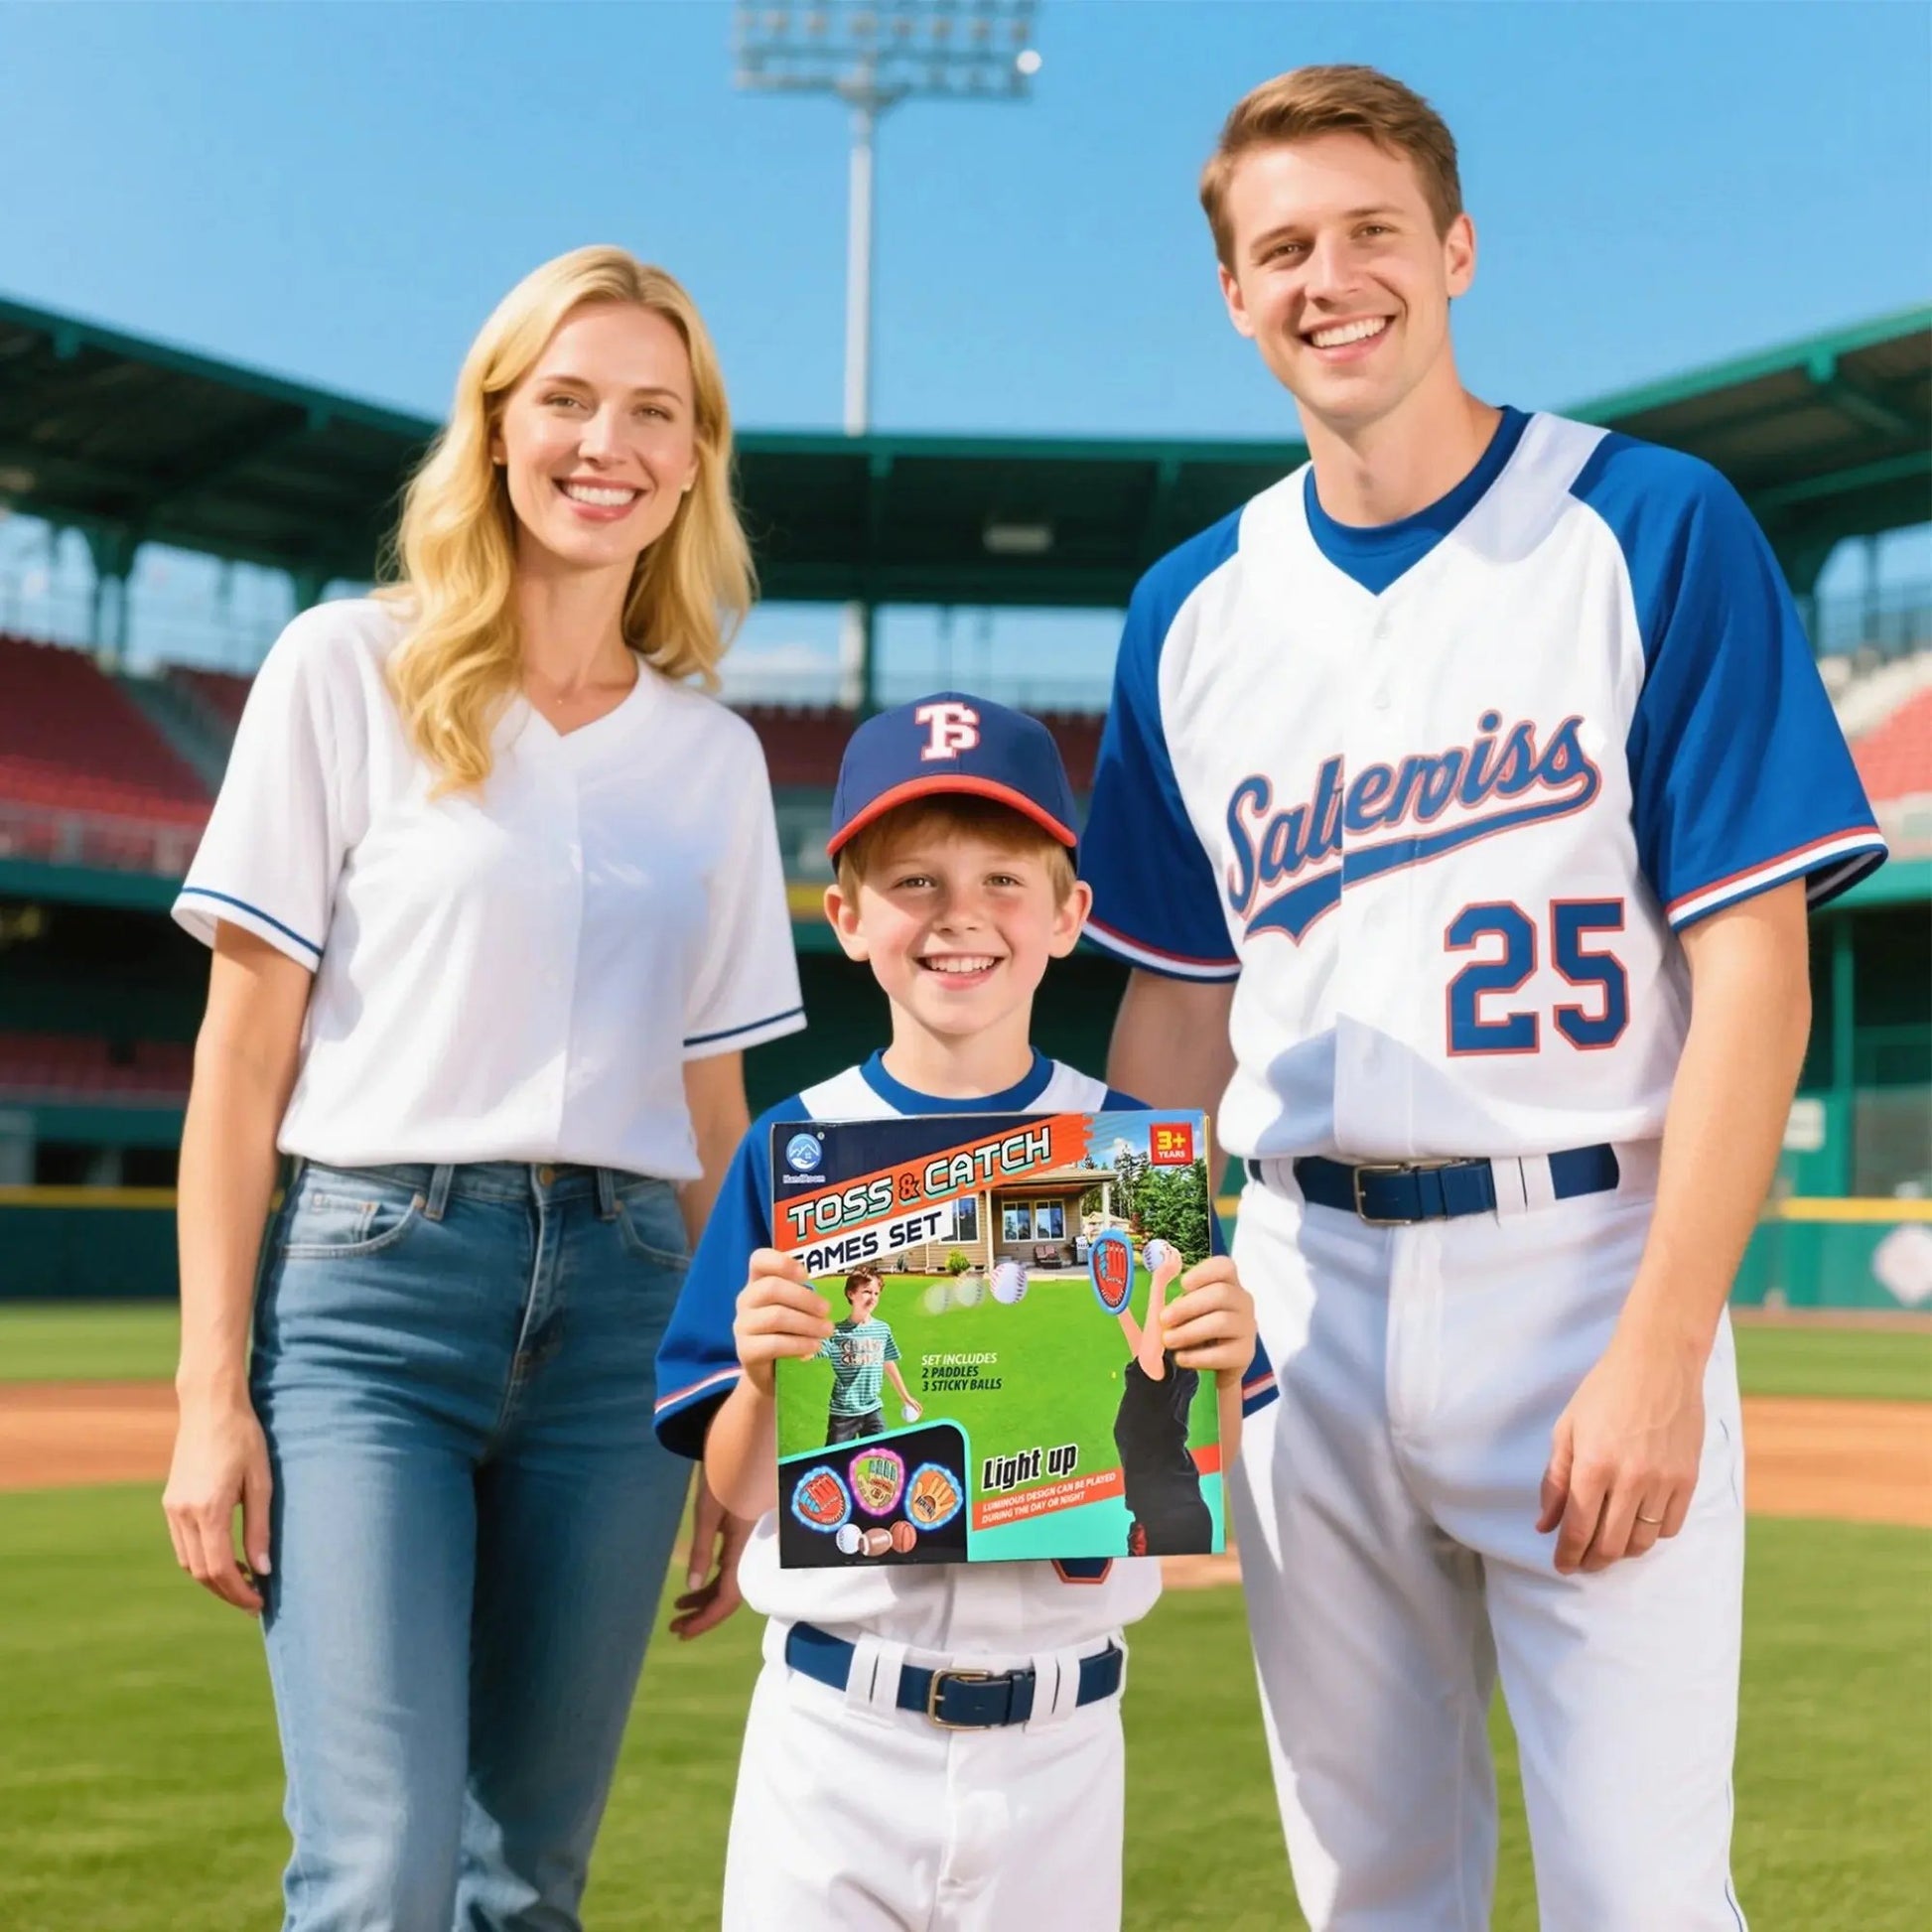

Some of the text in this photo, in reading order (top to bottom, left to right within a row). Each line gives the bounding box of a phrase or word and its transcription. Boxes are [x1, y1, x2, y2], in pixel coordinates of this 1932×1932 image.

[1444, 897, 1630, 1057] 25
[1157, 1130, 1186, 1151] 3+
[1159, 1150, 1185, 1159] YEARS
[787, 1124, 1051, 1241] TOSS & CATCH
[889, 1211, 942, 1249] SET
[921, 1352, 998, 1366] SET INCLUDES
[922, 1365, 979, 1378] 2 PADDLES
[922, 1378, 1002, 1391] 3 STICKY BALLS
[982, 1443, 1078, 1491] Light up
[981, 1490, 1086, 1524] DURING THE DAY OR NIGHT
[983, 1472, 1116, 1512] LUMINOUS DESIGN CAN BE PLAYED
